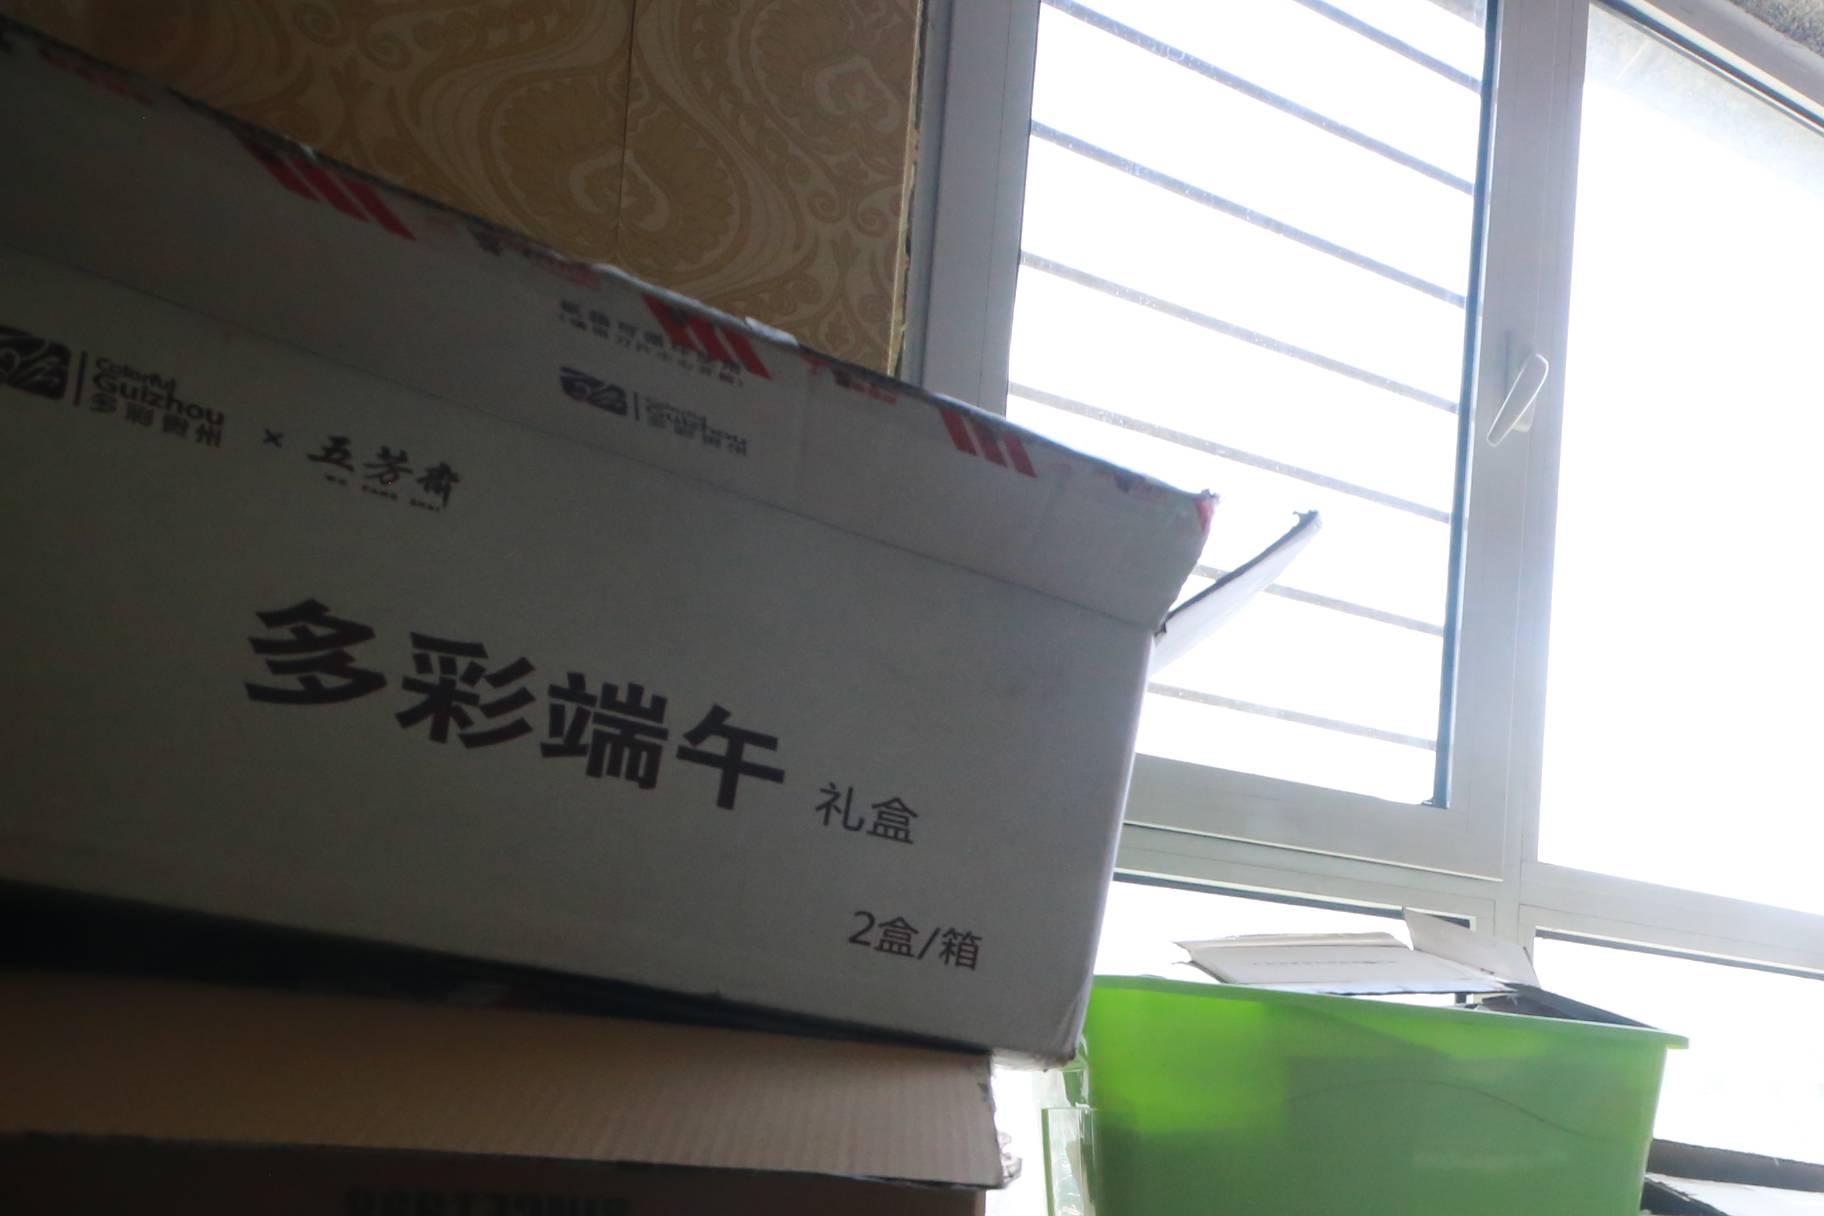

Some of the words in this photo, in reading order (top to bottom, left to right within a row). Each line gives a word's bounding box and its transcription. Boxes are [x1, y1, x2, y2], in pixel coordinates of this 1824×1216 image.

[93, 372, 226, 426] Guizhou
[244, 598, 786, 811] 多彩端午
[814, 780, 919, 845] 礼盒
[847, 910, 984, 971] 2盒/箱
